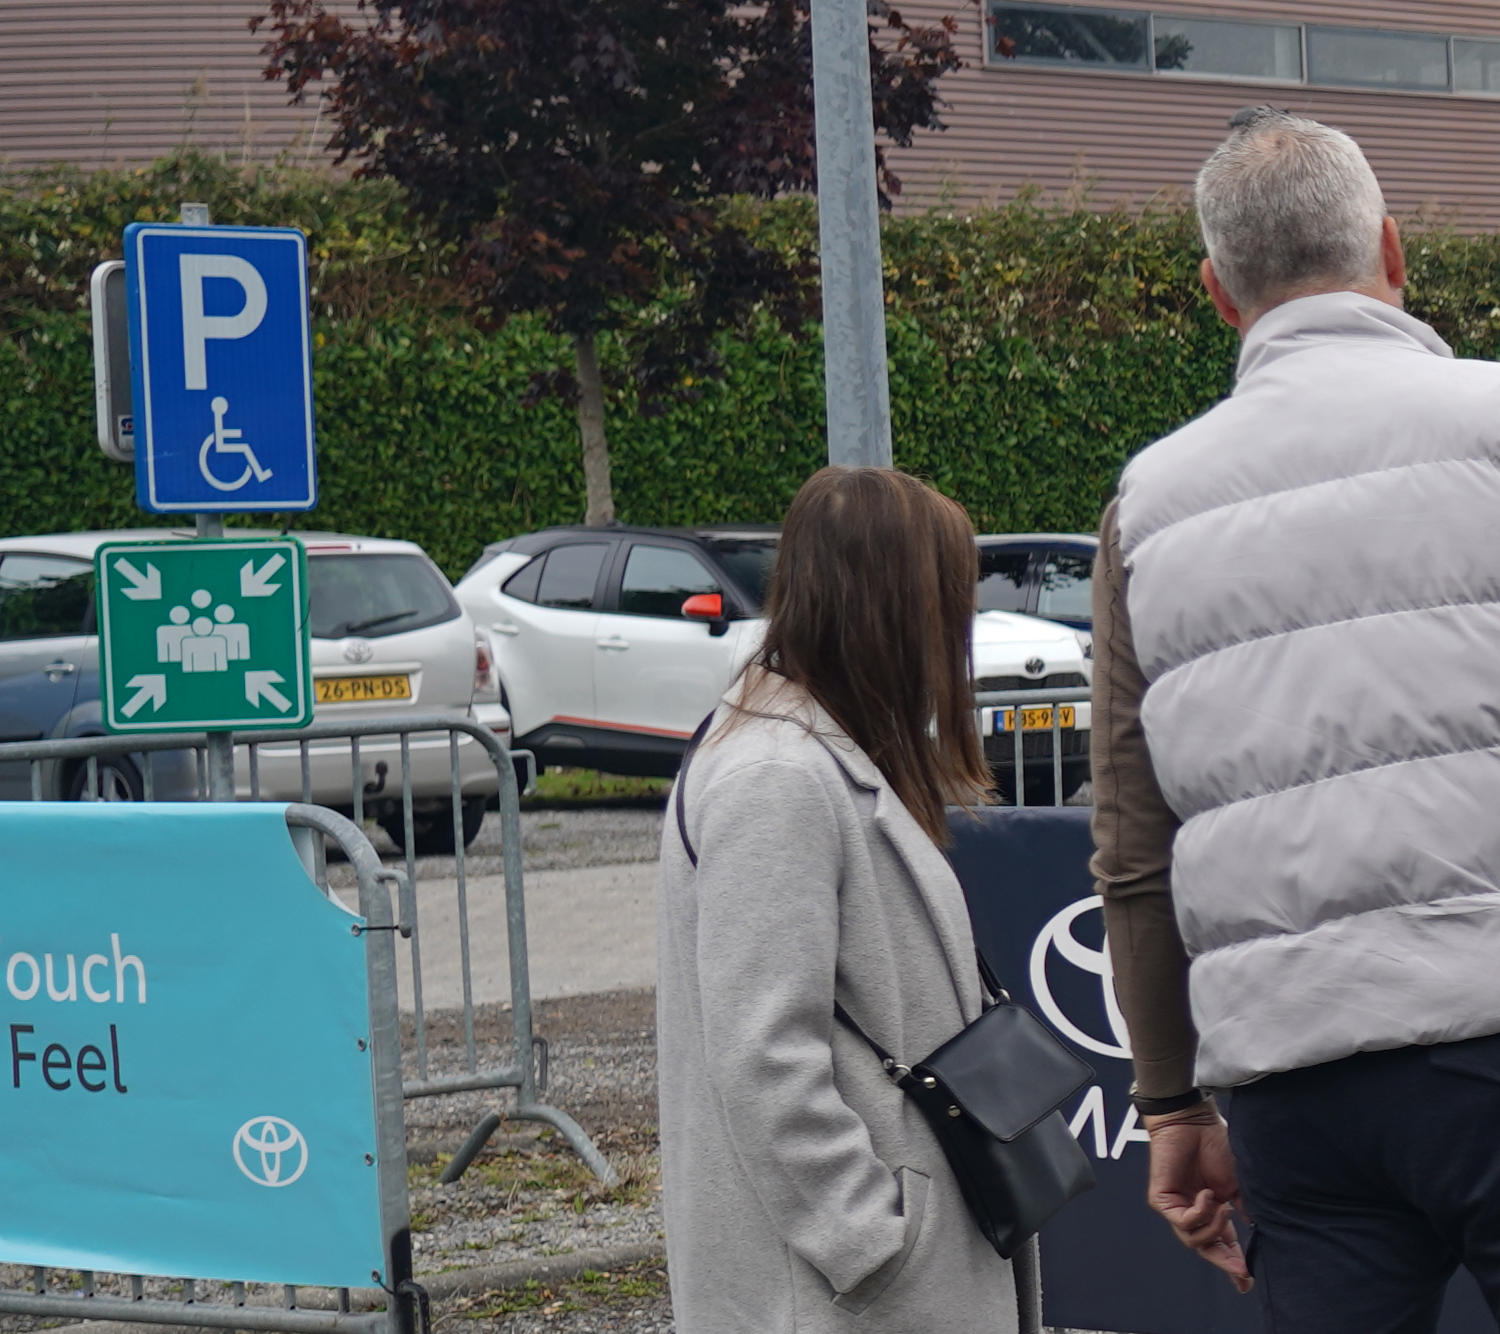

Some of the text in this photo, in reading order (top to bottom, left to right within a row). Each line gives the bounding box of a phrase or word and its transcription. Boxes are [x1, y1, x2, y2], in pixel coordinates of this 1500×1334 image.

[179, 253, 268, 390] P
[321, 679, 406, 700] 26-PN-DS
[1, 932, 148, 1005] ouch
[9, 1023, 128, 1094] Feel
